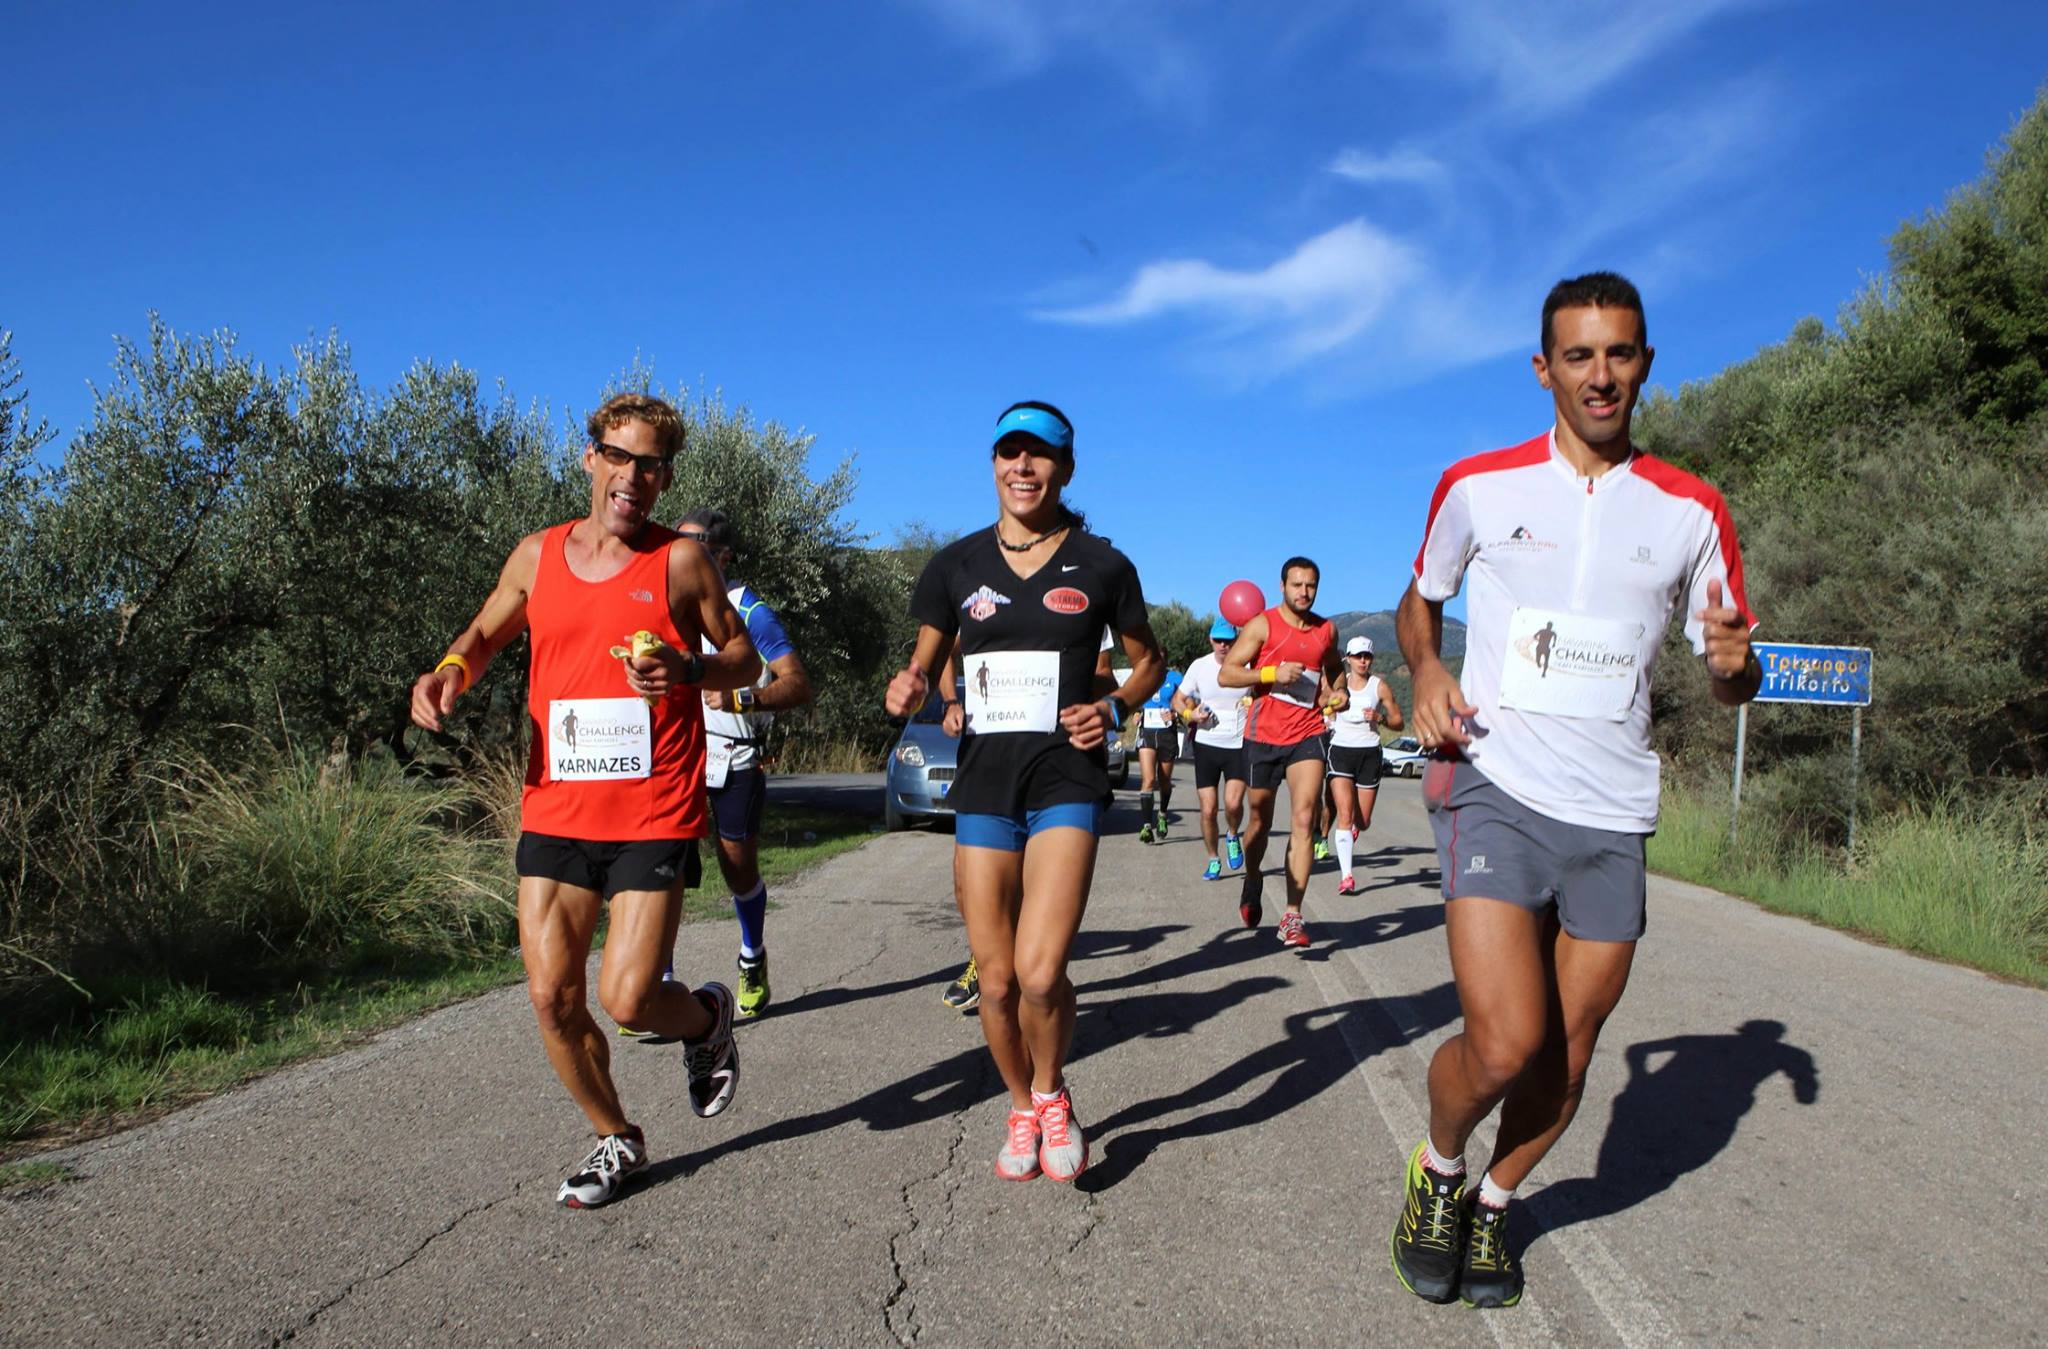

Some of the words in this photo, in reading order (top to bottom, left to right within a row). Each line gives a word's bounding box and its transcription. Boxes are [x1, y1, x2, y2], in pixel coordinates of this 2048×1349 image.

[1555, 648, 1637, 667] CHALLENGE
[990, 676, 1056, 688] CHALLENGE
[986, 711, 1027, 722] ΚΕΦΑΛΑ
[578, 724, 646, 737] CHALLENGE
[558, 756, 641, 774] KARNAZES
